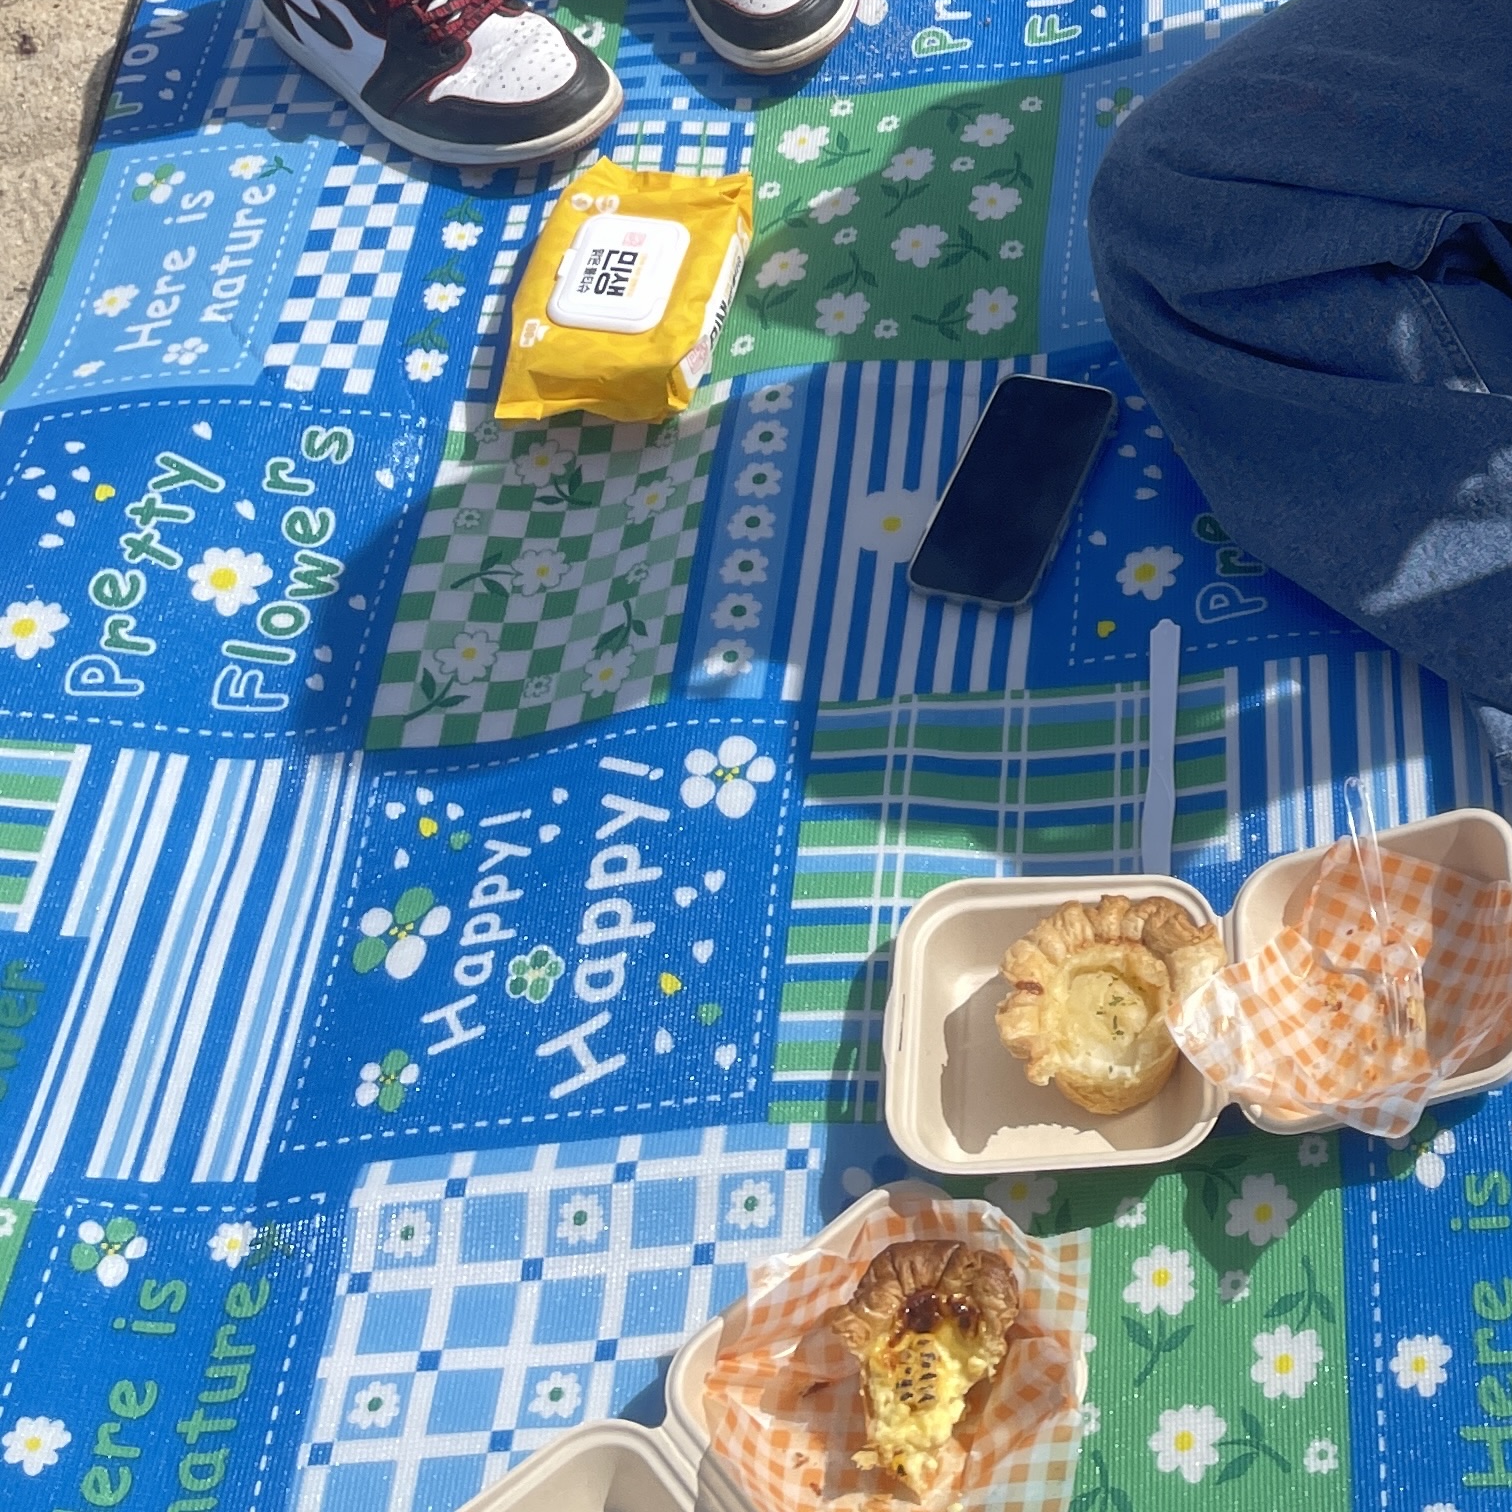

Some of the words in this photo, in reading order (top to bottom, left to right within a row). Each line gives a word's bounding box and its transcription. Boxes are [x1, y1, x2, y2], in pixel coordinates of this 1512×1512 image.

[116, 248, 197, 354] Here
[164, 187, 214, 226] is
[199, 182, 276, 325] nature
[594, 249, 639, 297] 민생
[65, 450, 226, 698] Pretty
[211, 424, 355, 713] Flowers
[1192, 511, 1269, 625] Pre
[420, 808, 533, 1056] Happy!
[535, 755, 672, 1100] Happy!
[1450, 1170, 1512, 1233] is
[52, 1379, 158, 1512] ere
[112, 1279, 188, 1335] is
